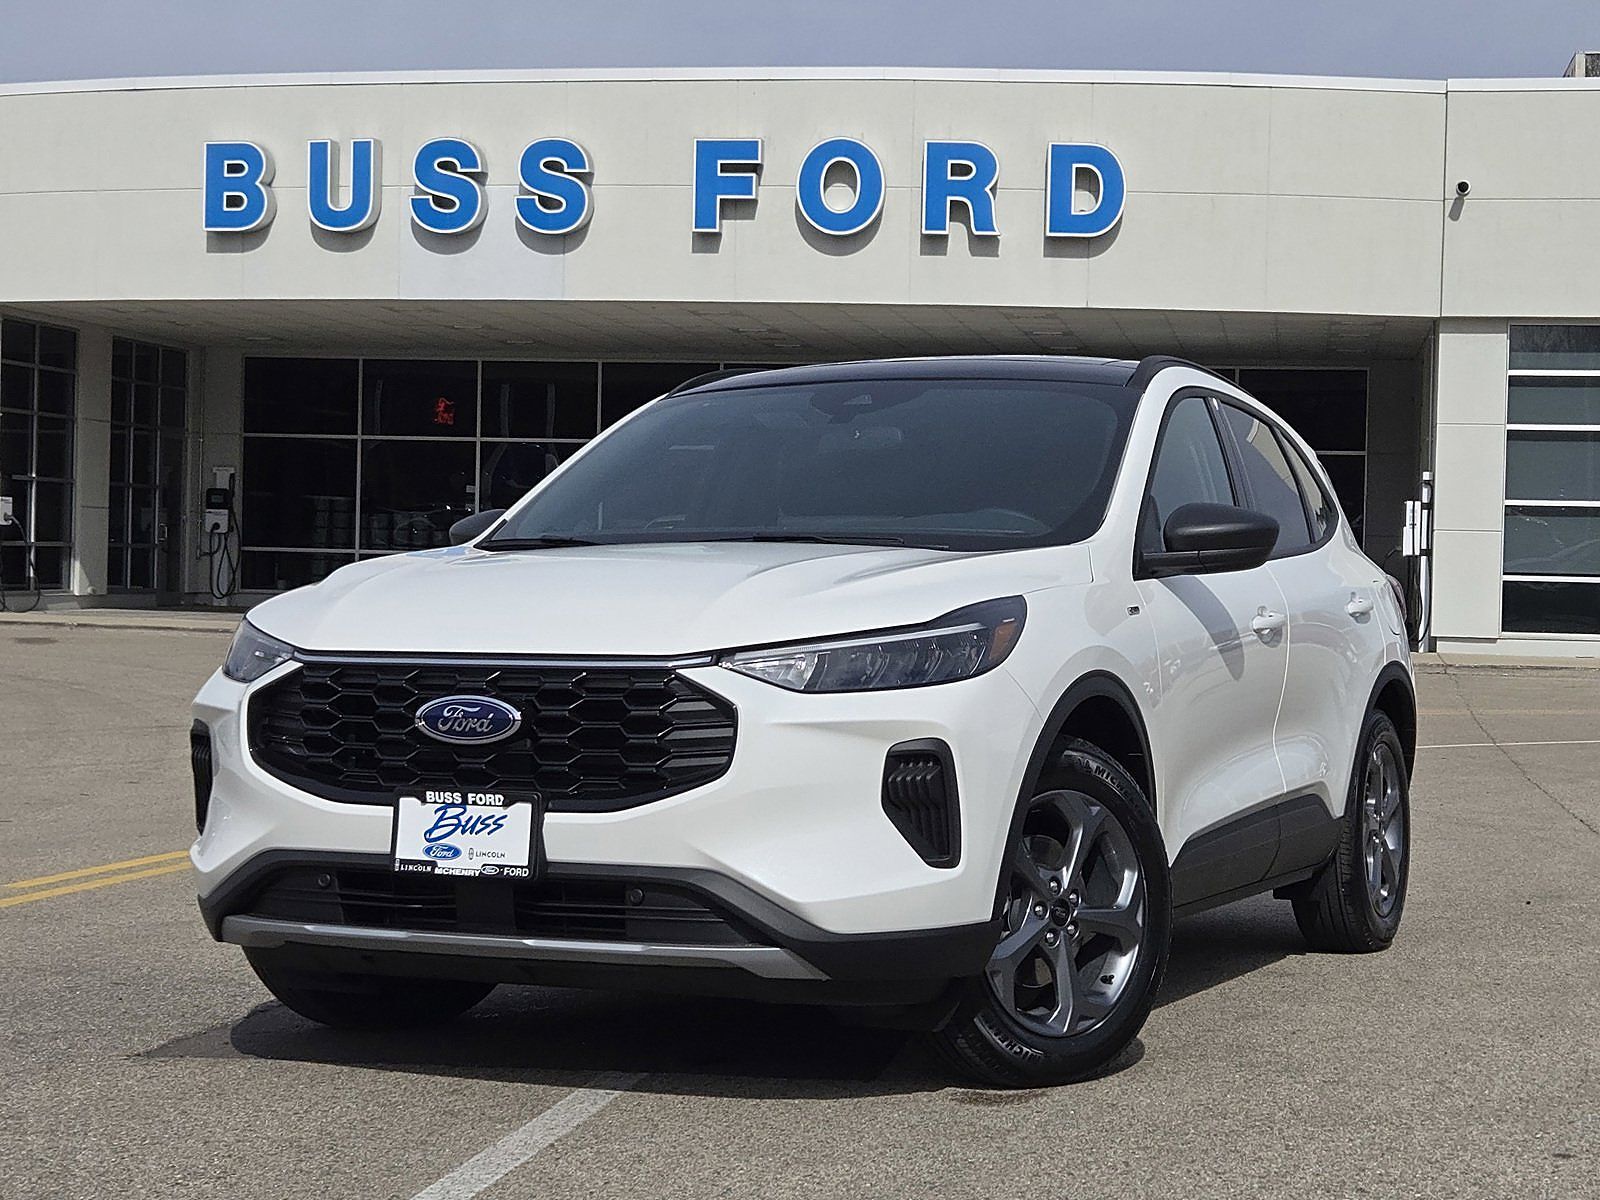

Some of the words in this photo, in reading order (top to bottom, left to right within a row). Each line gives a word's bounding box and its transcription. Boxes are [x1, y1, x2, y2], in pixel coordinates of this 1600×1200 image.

[202, 137, 592, 234] BUSS
[691, 136, 1127, 238] FORD
[437, 705, 494, 733] Ford
[425, 790, 462, 804] BUSS
[467, 792, 505, 806] FORD
[424, 803, 508, 843] Buss
[429, 844, 455, 858] Ford
[475, 850, 506, 859] LINCOLN
[400, 863, 432, 872] LINCOLN
[503, 867, 529, 877] FORD
